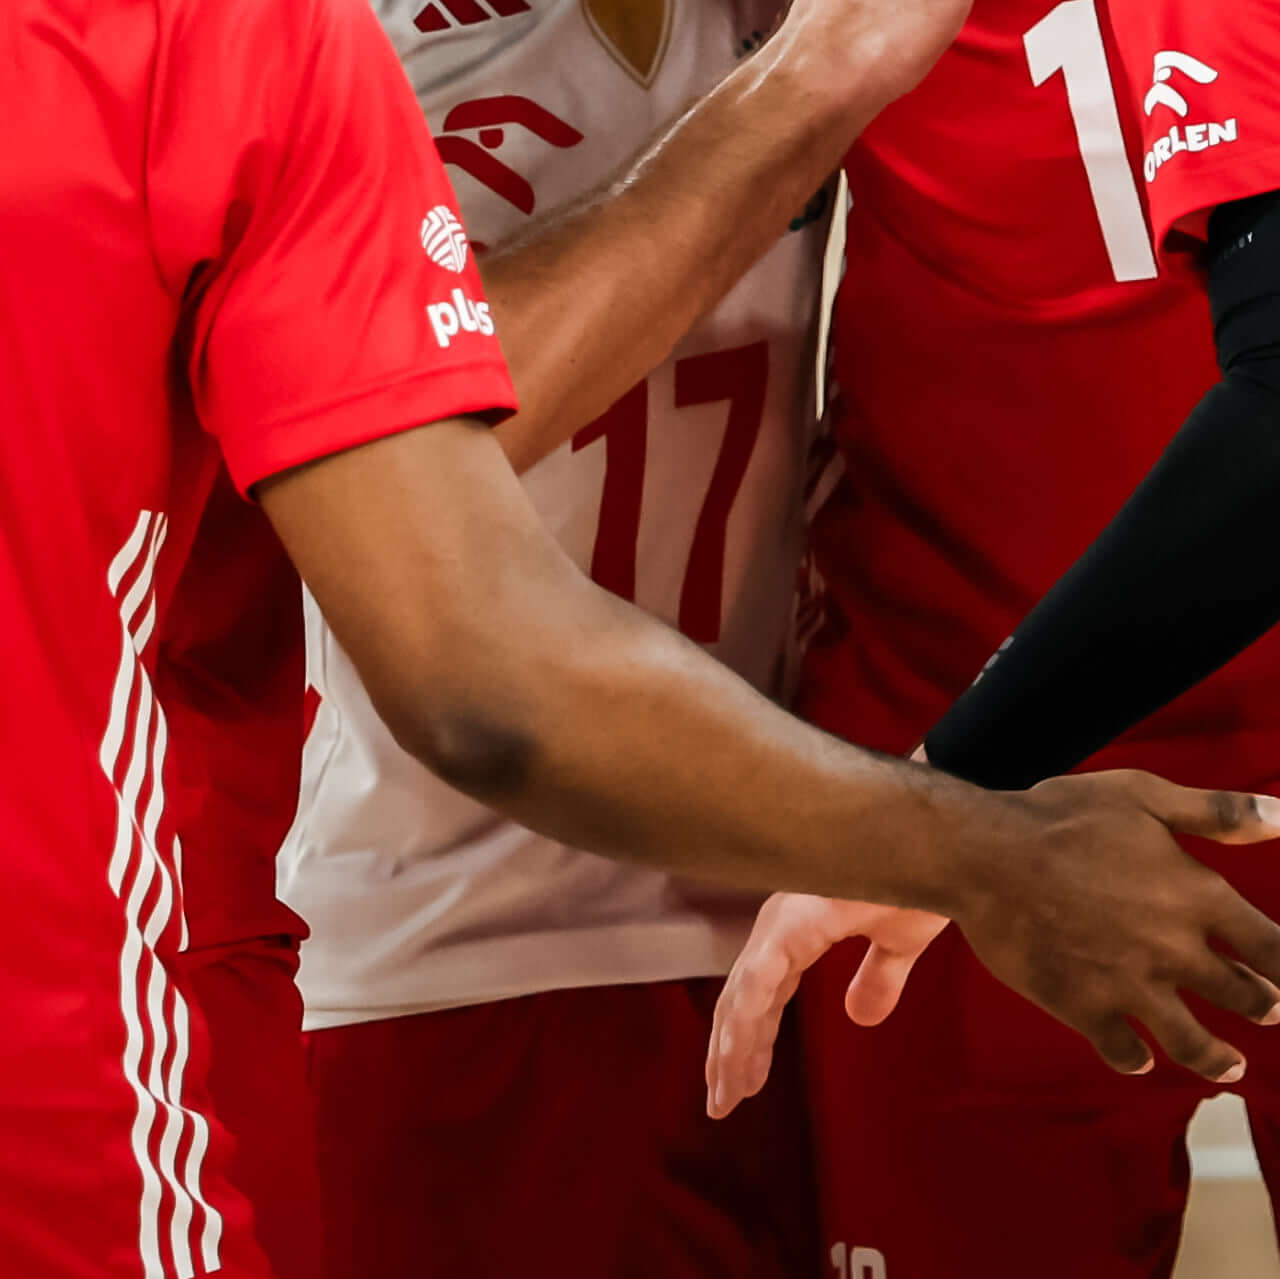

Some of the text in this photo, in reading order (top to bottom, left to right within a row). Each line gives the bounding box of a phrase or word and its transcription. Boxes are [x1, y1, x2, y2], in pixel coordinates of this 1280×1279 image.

[1143, 118, 1238, 184] ORLEN
[426, 287, 495, 348] plus
[572, 340, 769, 645] 17
